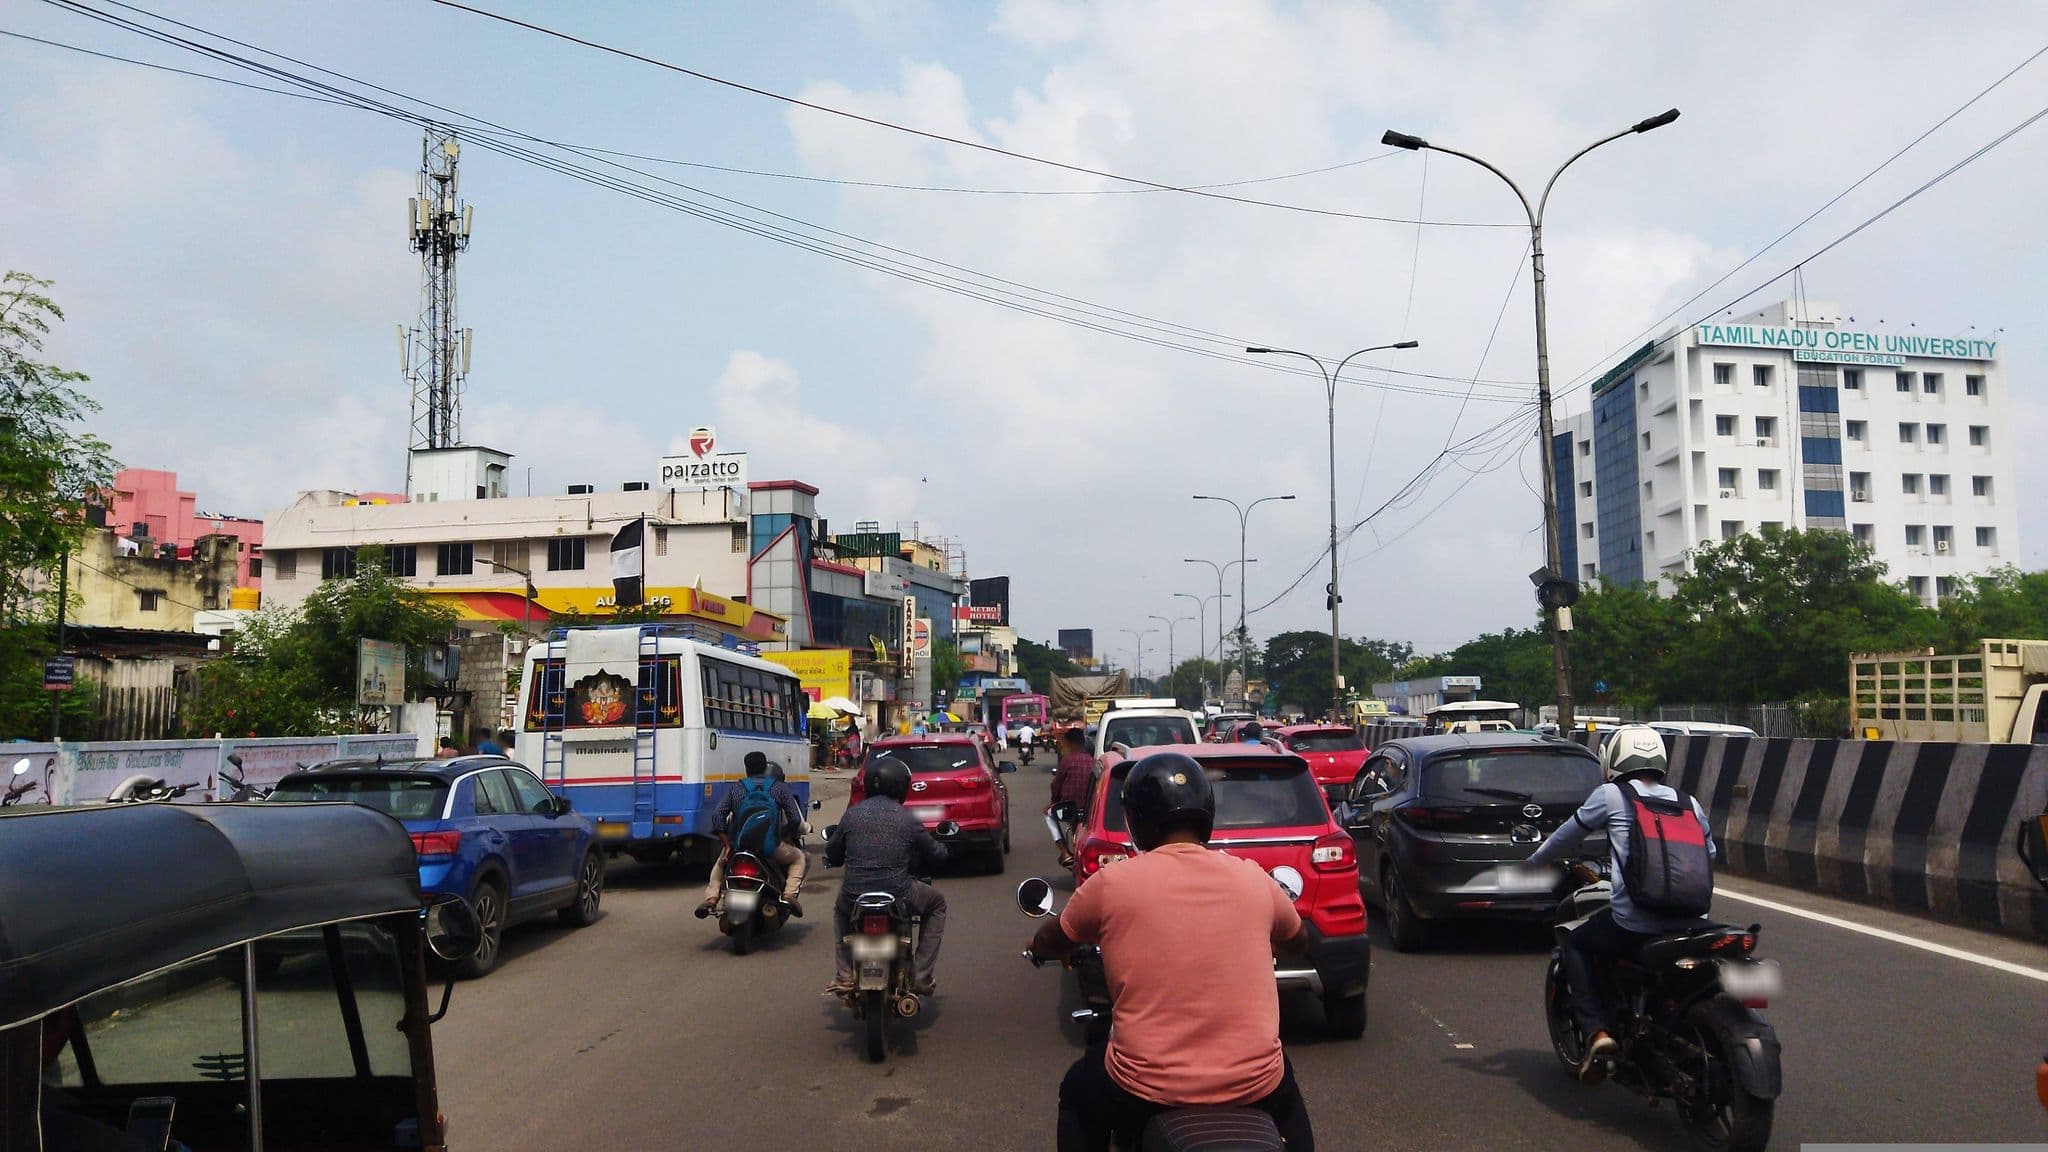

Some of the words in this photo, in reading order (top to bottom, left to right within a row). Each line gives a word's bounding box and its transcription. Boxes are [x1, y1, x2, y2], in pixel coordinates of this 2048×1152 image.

[1700, 325, 1818, 347] TAMILNADU
[1825, 331, 1879, 350] OPEN
[1885, 335, 1996, 358] UNIVERSITY
[1796, 351, 1859, 363] EDUCATION
[1863, 354, 1882, 364] FOR
[1885, 355, 1905, 365] ALL
[642, 595, 671, 606] LPG
[575, 746, 628, 755] Mahindra
